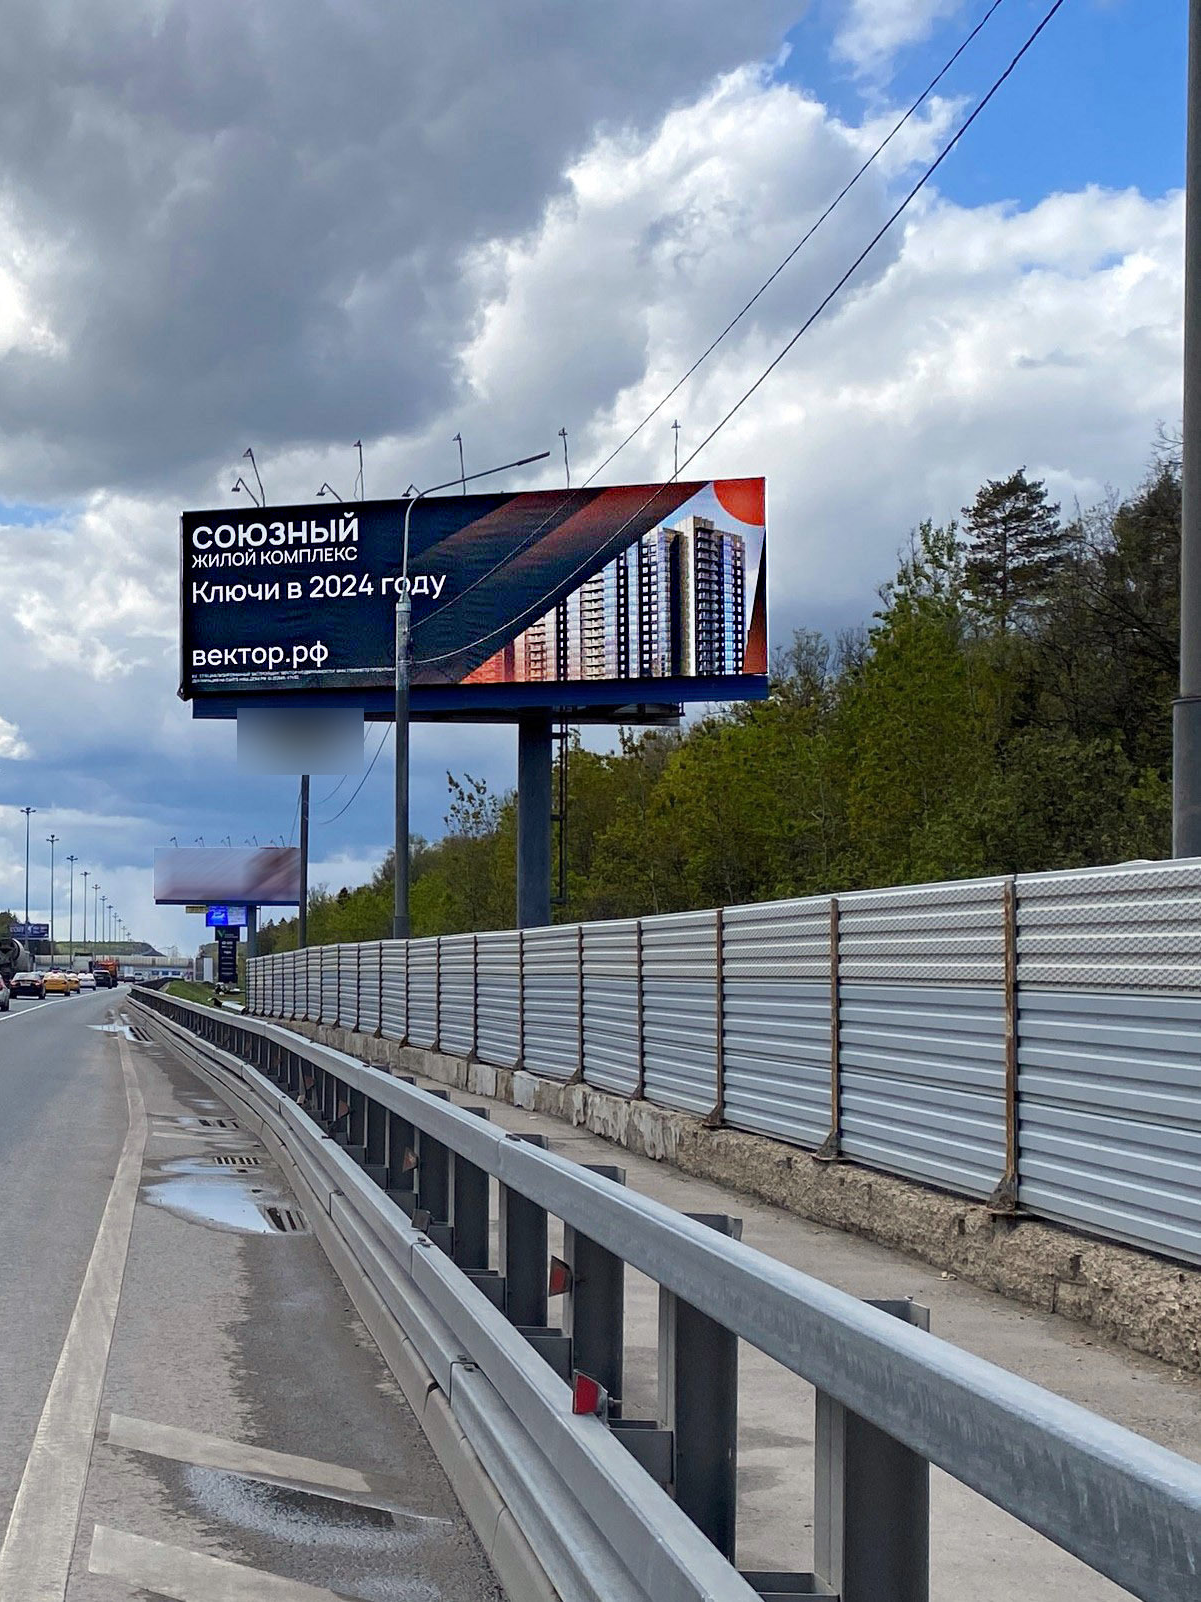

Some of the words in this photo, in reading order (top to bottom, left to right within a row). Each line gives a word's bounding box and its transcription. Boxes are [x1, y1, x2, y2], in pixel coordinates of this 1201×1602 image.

[192, 511, 359, 549] СОЮЗНЫЙ
[191, 548, 256, 569] ЖИЛОЙ
[260, 546, 358, 566] КОМПЛЕКС
[192, 581, 280, 604] Ключи
[287, 581, 303, 599] в
[309, 573, 375, 599] 2024
[381, 574, 447, 600] году
[192, 640, 329, 670] вектор.рф
